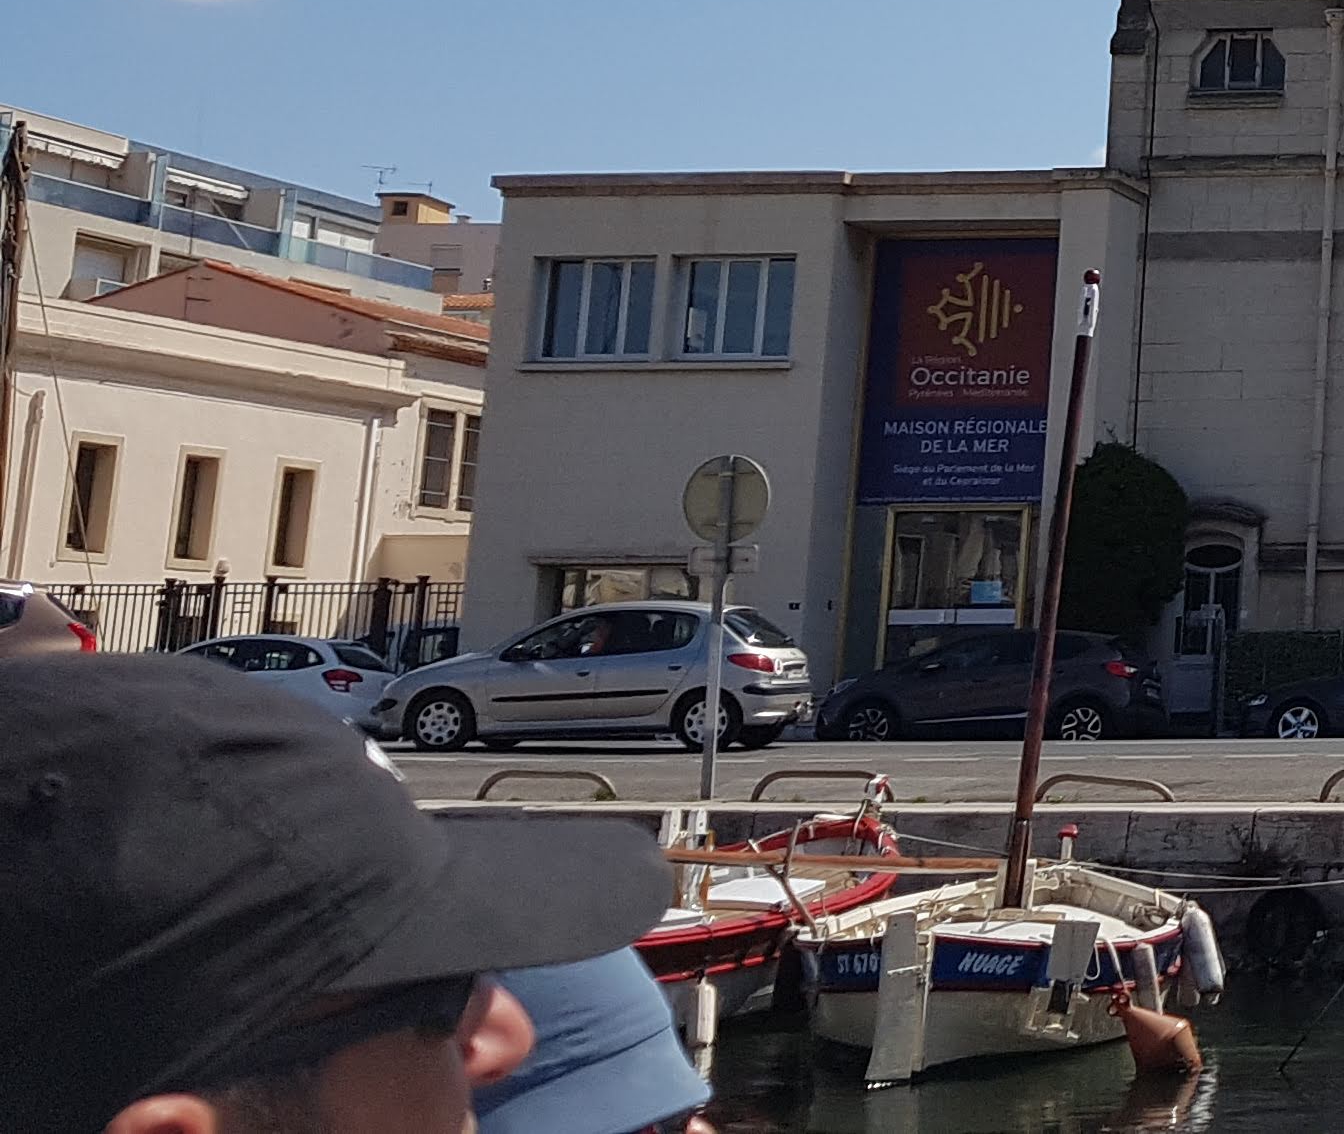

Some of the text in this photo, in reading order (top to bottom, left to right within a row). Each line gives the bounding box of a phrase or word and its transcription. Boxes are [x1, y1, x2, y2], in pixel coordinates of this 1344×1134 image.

[910, 365, 1030, 386] Occitanie
[884, 417, 1047, 435] MAISON RÉGIONALE
[920, 439, 1009, 453] DE LA MER
[957, 951, 1024, 976] NUAGE
